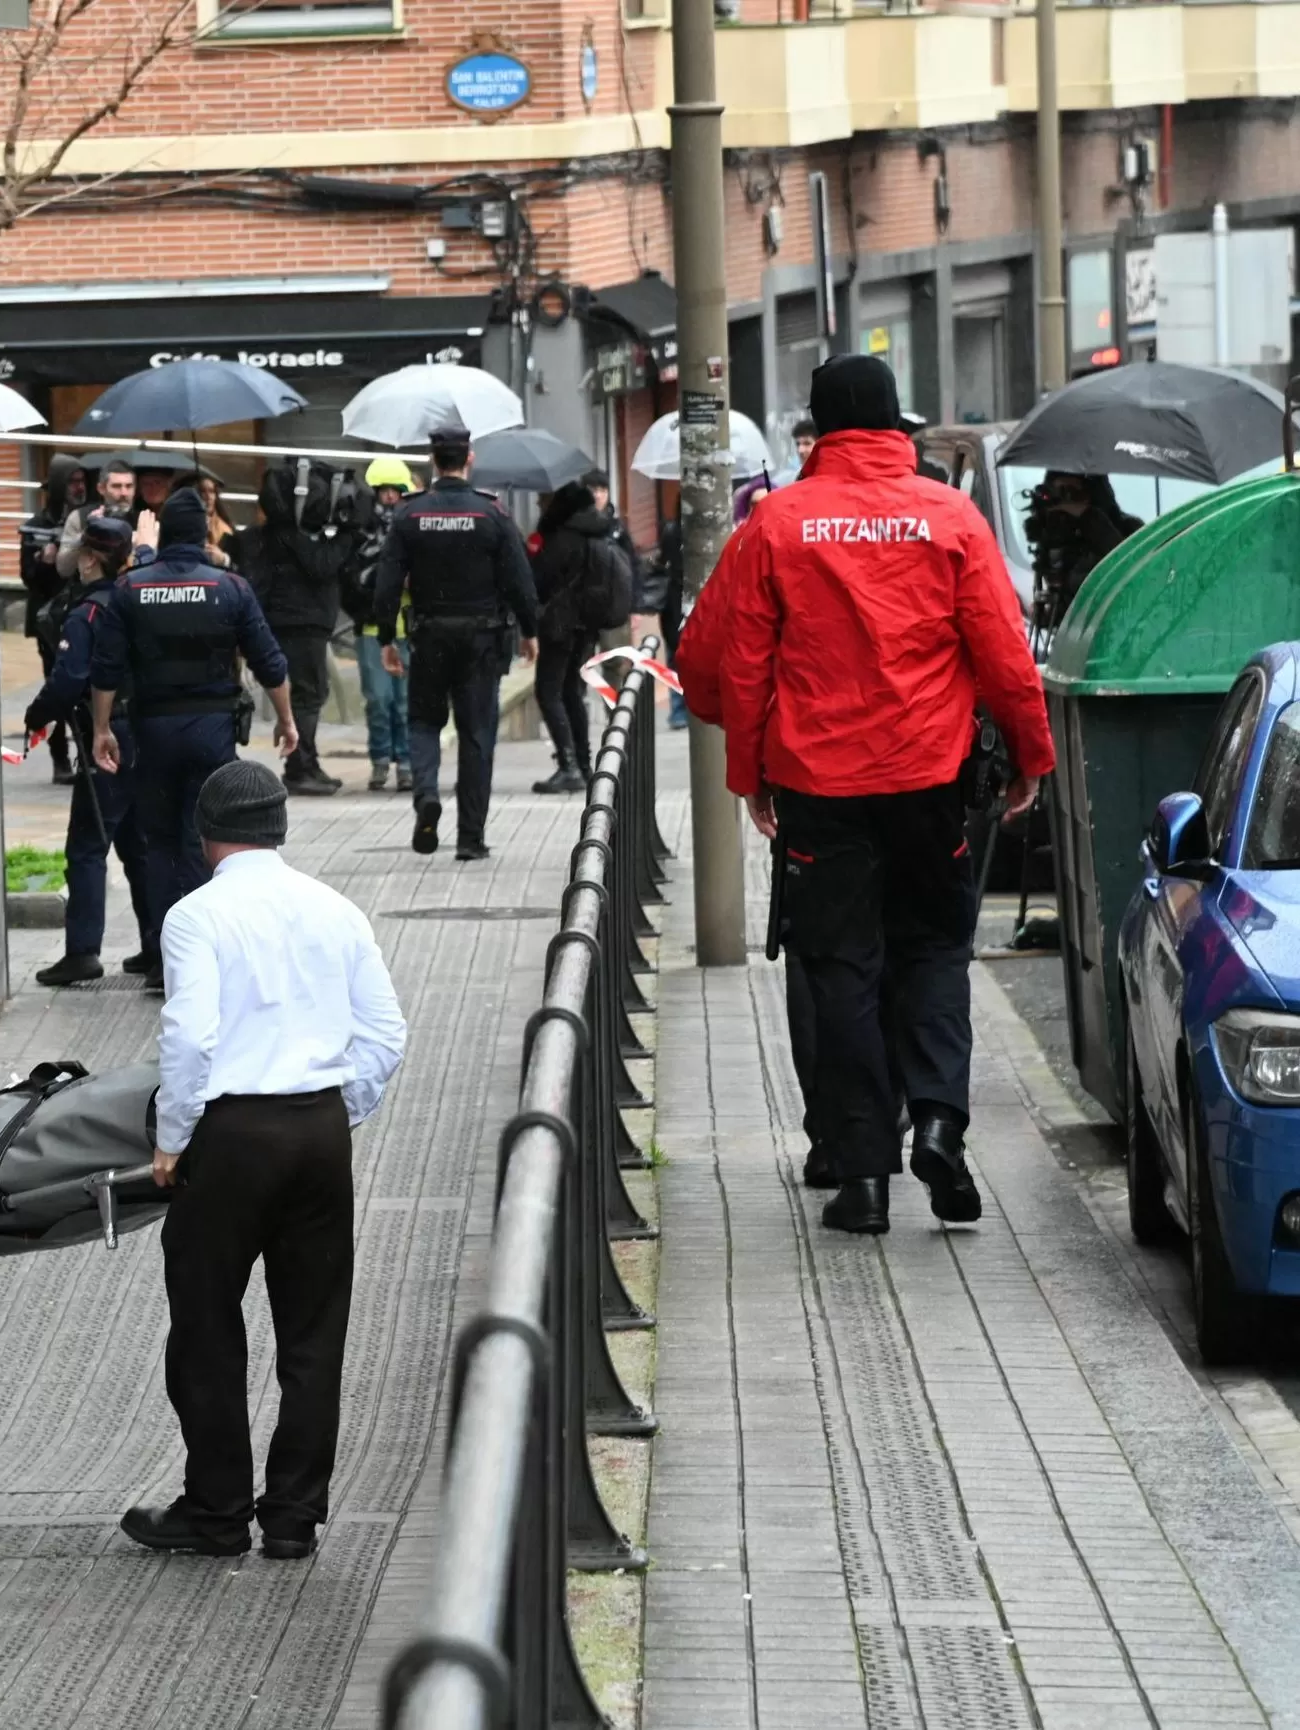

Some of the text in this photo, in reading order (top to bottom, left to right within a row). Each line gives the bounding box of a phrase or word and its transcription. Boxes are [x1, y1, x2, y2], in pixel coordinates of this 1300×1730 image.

[452, 71, 474, 84] SAN
[419, 515, 475, 531] ERTZAINTZA
[802, 517, 931, 543] ERTZAINTZA
[140, 585, 206, 604] ERTZAINTZA
